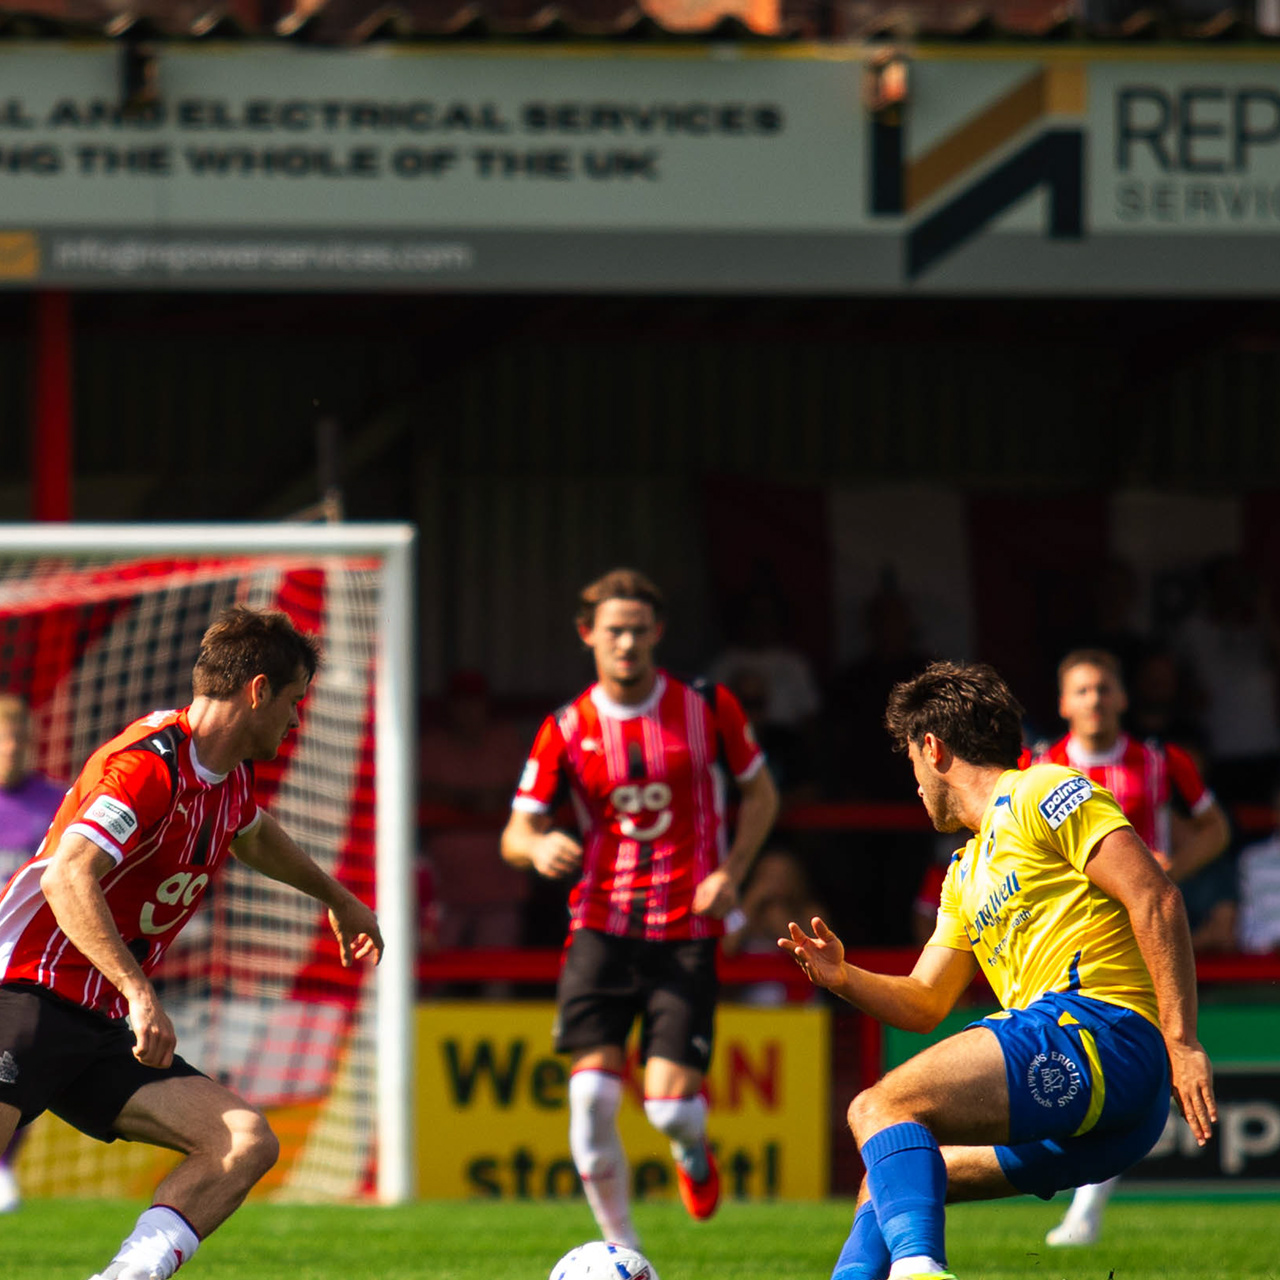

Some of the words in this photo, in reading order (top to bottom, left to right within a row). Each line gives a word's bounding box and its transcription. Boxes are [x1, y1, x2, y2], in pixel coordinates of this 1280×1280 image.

[45, 97, 167, 131] AND
[177, 98, 508, 133] ELECTRICAL
[522, 101, 785, 137] SERVICES
[75, 143, 173, 178] THE
[185, 144, 383, 179] WHOLE
[391, 145, 458, 180] OF
[471, 146, 576, 181] THE
[581, 147, 661, 182] UK
[1053, 792, 1085, 823] TYRES
[441, 1038, 569, 1109] We
[1051, 1050, 1076, 1072] ERIC
[1057, 1072, 1081, 1107] LYONS
[467, 1147, 669, 1200] stoe
